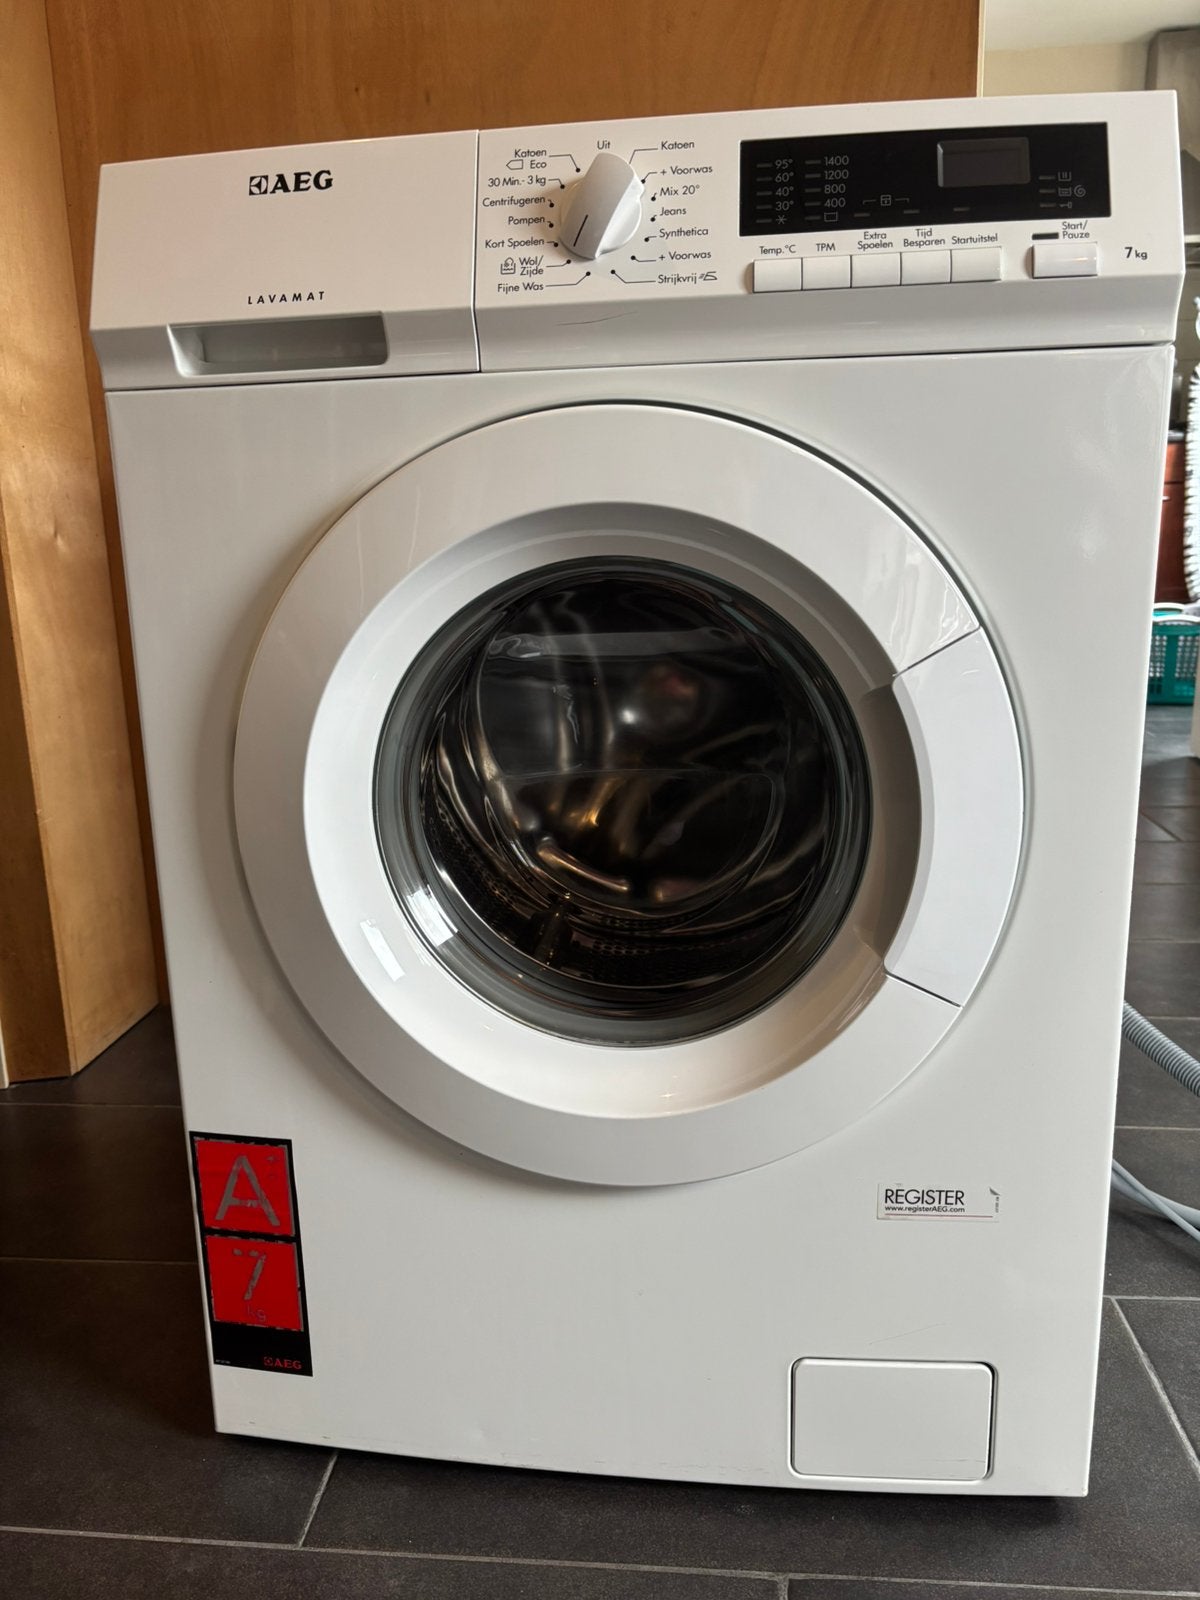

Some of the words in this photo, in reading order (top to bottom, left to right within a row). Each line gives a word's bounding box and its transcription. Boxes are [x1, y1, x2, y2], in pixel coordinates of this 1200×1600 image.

[597, 140, 610, 150] Uit
[661, 140, 695, 150] Katoen
[514, 149, 547, 158] Katoen
[530, 160, 547, 169] Eco
[824, 155, 849, 166] 1400
[670, 165, 713, 175] Voorwas
[824, 169, 849, 180] 1200
[270, 170, 333, 194] AEG
[488, 178, 501, 187] 30
[527, 176, 534, 185] 3
[536, 175, 546, 186] kg
[660, 187, 679, 196] Mix
[824, 183, 846, 194] 800
[482, 196, 546, 208] Centrifugeren
[824, 197, 846, 208] 400
[660, 207, 687, 216] Jeans
[508, 215, 546, 226] Pompen
[1062, 221, 1088, 231] Start/
[659, 227, 709, 238] Synthetica
[863, 231, 887, 240] Extra
[916, 228, 932, 239] Tijd
[1062, 231, 1090, 239] Pauze
[485, 239, 505, 249] Kort
[507, 237, 545, 249] Spoelen
[903, 238, 945, 248] Besparen
[951, 233, 998, 245] Startuitstel
[816, 243, 836, 252] TPM
[857, 240, 893, 250] Spoelen
[669, 250, 712, 260] Voorwas
[1124, 247, 1133, 258] 7
[1134, 250, 1148, 260] kg
[519, 255, 544, 267] Wol/
[520, 266, 544, 277] Zijde
[657, 274, 697, 285] Strijkvrij
[497, 283, 520, 295] Fijne
[522, 282, 544, 292] Was
[248, 291, 325, 305] LAVAMAT
[884, 1189, 965, 1206] REGISTER
[885, 1205, 965, 1213] www.registerAEG.com
[232, 1248, 267, 1300] 7
[274, 1358, 302, 1370] AEG
